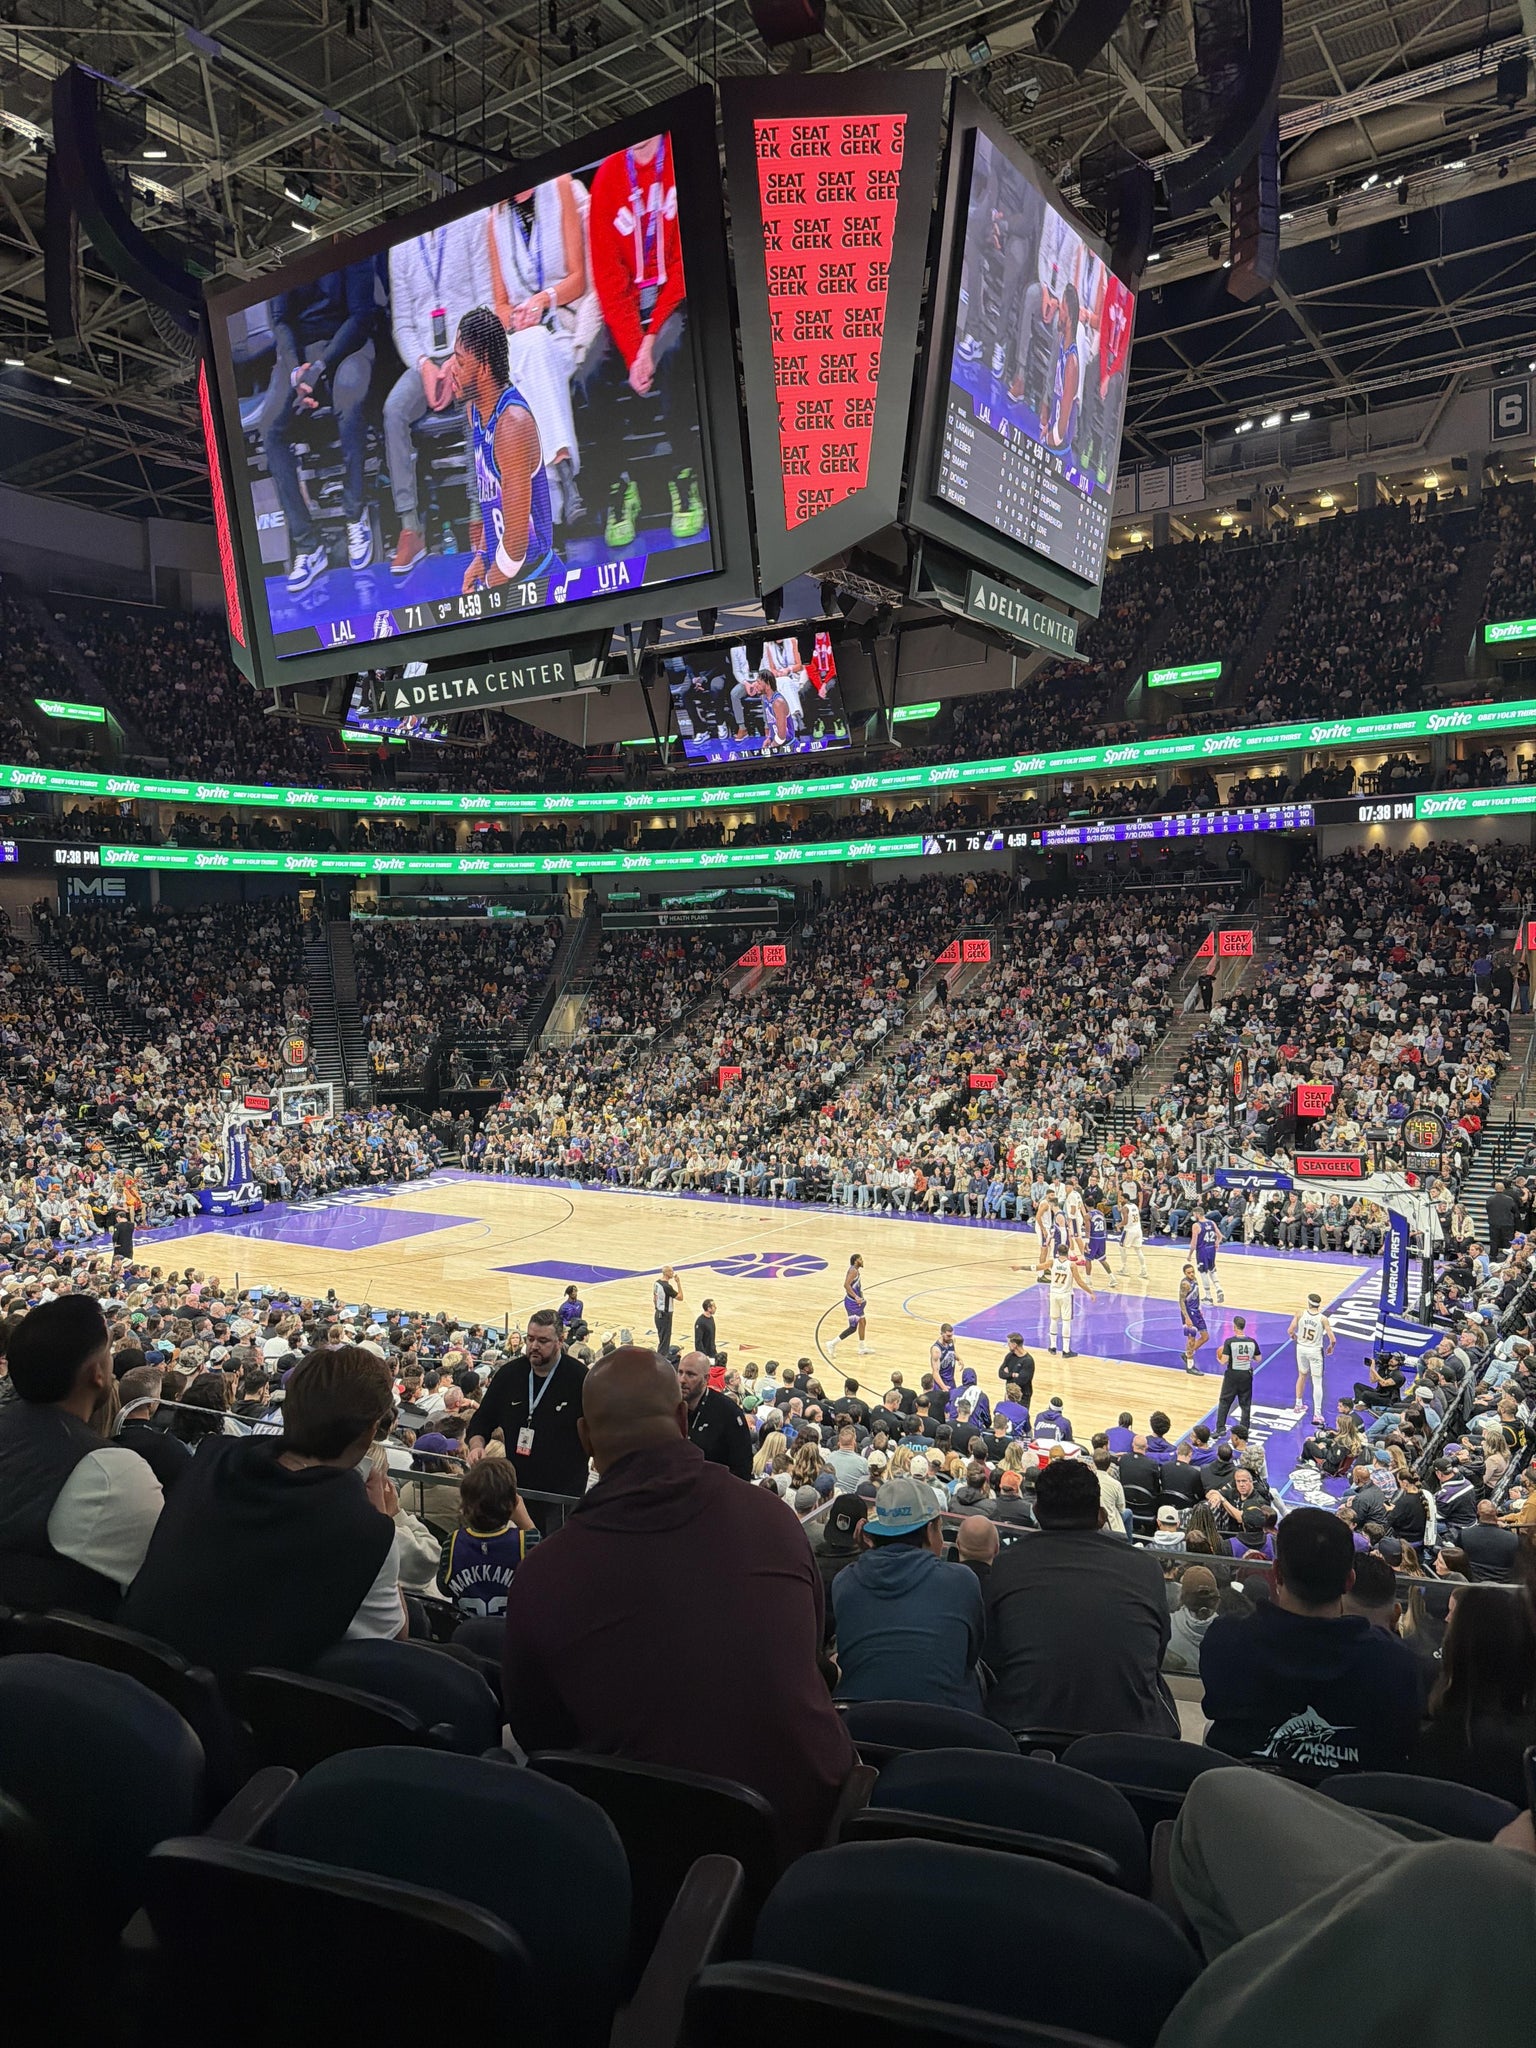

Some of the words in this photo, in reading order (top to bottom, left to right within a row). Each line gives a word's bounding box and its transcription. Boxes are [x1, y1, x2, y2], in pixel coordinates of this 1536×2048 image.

[792, 126, 829, 140] SEAT
[842, 123, 880, 138] SEAT
[790, 142, 831, 157] GEEK
[841, 140, 881, 155] GEEK
[767, 173, 805, 188] SEAT
[818, 171, 855, 186] SEAT
[766, 189, 806, 204] GEEK
[816, 188, 857, 203] GEEK
[866, 186, 899, 201] GEE
[794, 218, 831, 234] SEAT
[843, 216, 881, 232] SEAT
[792, 234, 832, 250] GEEK
[842, 232, 882, 248] GEEK
[769, 265, 806, 280] SEAT
[819, 263, 856, 279] SEAT
[768, 281, 808, 296] GEEK
[817, 279, 858, 294] GEEK
[795, 309, 832, 325] SEAT
[845, 307, 882, 323] SEAT
[793, 325, 834, 341] GEEK
[843, 323, 883, 339] GEEK
[774, 355, 808, 370] SEAT
[820, 354, 857, 369] SEAT
[818, 369, 859, 385] GEEK
[797, 400, 833, 415] SEAT
[1499, 394, 1522, 427] 6
[794, 415, 835, 431] GEEK
[955, 420, 975, 440] LARAVIA
[821, 443, 858, 458] SEAT
[953, 438, 971, 455] KLEBER
[980, 403, 991, 424] LAL
[1013, 428, 1021, 445] 71
[1054, 457, 1062, 474] 76
[1080, 475, 1089, 493] UTA
[819, 458, 859, 474] GEEK
[942, 466, 949, 476] 77
[951, 455, 969, 471] SMART
[798, 488, 834, 504] SEAT
[948, 488, 966, 505] REAVES
[1037, 524, 1047, 537] LOVE
[1034, 539, 1051, 554] GEORGE
[331, 620, 356, 643] LAL
[405, 607, 423, 629] 71
[458, 594, 482, 619] 4:59
[489, 593, 501, 609] 19
[517, 583, 538, 606] 76
[598, 562, 629, 589] UTA
[988, 591, 1029, 627] DELTA
[1033, 613, 1074, 646] CENTER
[1490, 624, 1524, 639] Sprite
[413, 677, 479, 704] DELTA
[485, 663, 565, 692] CENTER
[1152, 670, 1178, 683] Sprite
[40, 702, 65, 714] Sprite
[10, 769, 47, 786] Sprite
[106, 779, 140, 795] Sprite
[195, 786, 230, 800] Sprite
[286, 791, 319, 804] Sprite
[373, 794, 406, 808] Sprite
[459, 797, 490, 809] Sprite
[543, 796, 574, 809] Sprite
[624, 794, 653, 807] Sprite
[701, 790, 730, 804] Sprite
[776, 784, 804, 798] Sprite
[850, 776, 879, 791] Sprite
[928, 768, 959, 783] Sprite
[1012, 758, 1046, 773] Sprite
[1103, 747, 1141, 764] Sprite
[1202, 736, 1242, 753] Sprite
[1309, 724, 1351, 742] Sprite
[1426, 712, 1473, 731] Sprite
[1358, 805, 1391, 822] 07:38
[1394, 803, 1413, 819] PM
[1421, 797, 1467, 815] Sprite
[946, 839, 957, 851] 71
[966, 838, 979, 850] 76
[1007, 833, 1027, 847] 4:59
[55, 850, 81, 864] 07:38
[84, 851, 99, 864] PM
[104, 850, 139, 864] Sprite
[194, 854, 229, 867] Sprite
[284, 856, 318, 870] Sprite
[372, 858, 405, 871] Sprite
[458, 859, 490, 872] Sprite
[542, 858, 573, 871] Sprite
[622, 856, 652, 869] Sprite
[700, 853, 729, 866] Sprite
[774, 847, 802, 861] Sprite
[848, 843, 876, 857] Sprite
[1224, 943, 1248, 951] GEEK
[1225, 935, 1247, 943] SEAT
[292, 1048, 303, 1063] 19
[1304, 1092, 1327, 1100] SEAT
[1304, 1100, 1328, 1108] GEEK
[1415, 1122, 1437, 1132] 4:59
[1418, 1133, 1433, 1146] 19
[1302, 1161, 1355, 1172] SEATGEEK
[1203, 1231, 1216, 1243] 42
[1391, 1230, 1400, 1259] FIRST
[1055, 1272, 1067, 1284] 77
[1387, 1260, 1399, 1306] AMERICA
[1302, 1327, 1315, 1341] 15
[1238, 1345, 1249, 1355] 24
[1291, 1742, 1359, 1762] MARLIN
